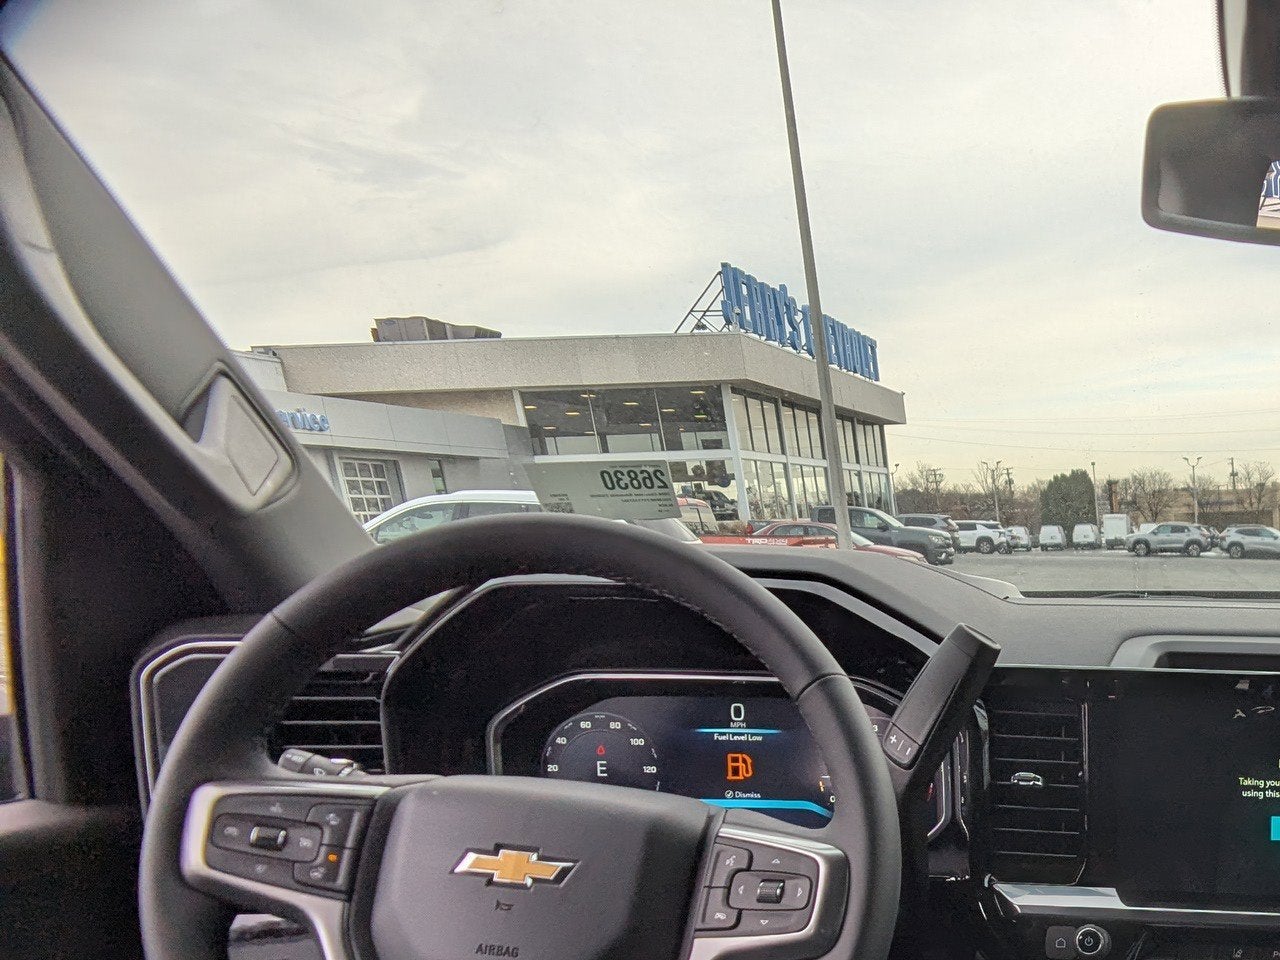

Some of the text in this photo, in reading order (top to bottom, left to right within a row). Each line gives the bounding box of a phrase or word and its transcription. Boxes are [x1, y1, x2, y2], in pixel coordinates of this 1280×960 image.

[580, 721, 592, 729] 60
[714, 733, 729, 741] Fuel
[630, 738, 645, 746] 100
[547, 764, 559, 772] 20
[596, 760, 608, 777] E
[643, 765, 657, 773] 120
[1239, 777, 1264, 788] Taking
[1242, 789, 1264, 799] using
[1265, 789, 1280, 798] this
[475, 943, 520, 958] AIRBAG
